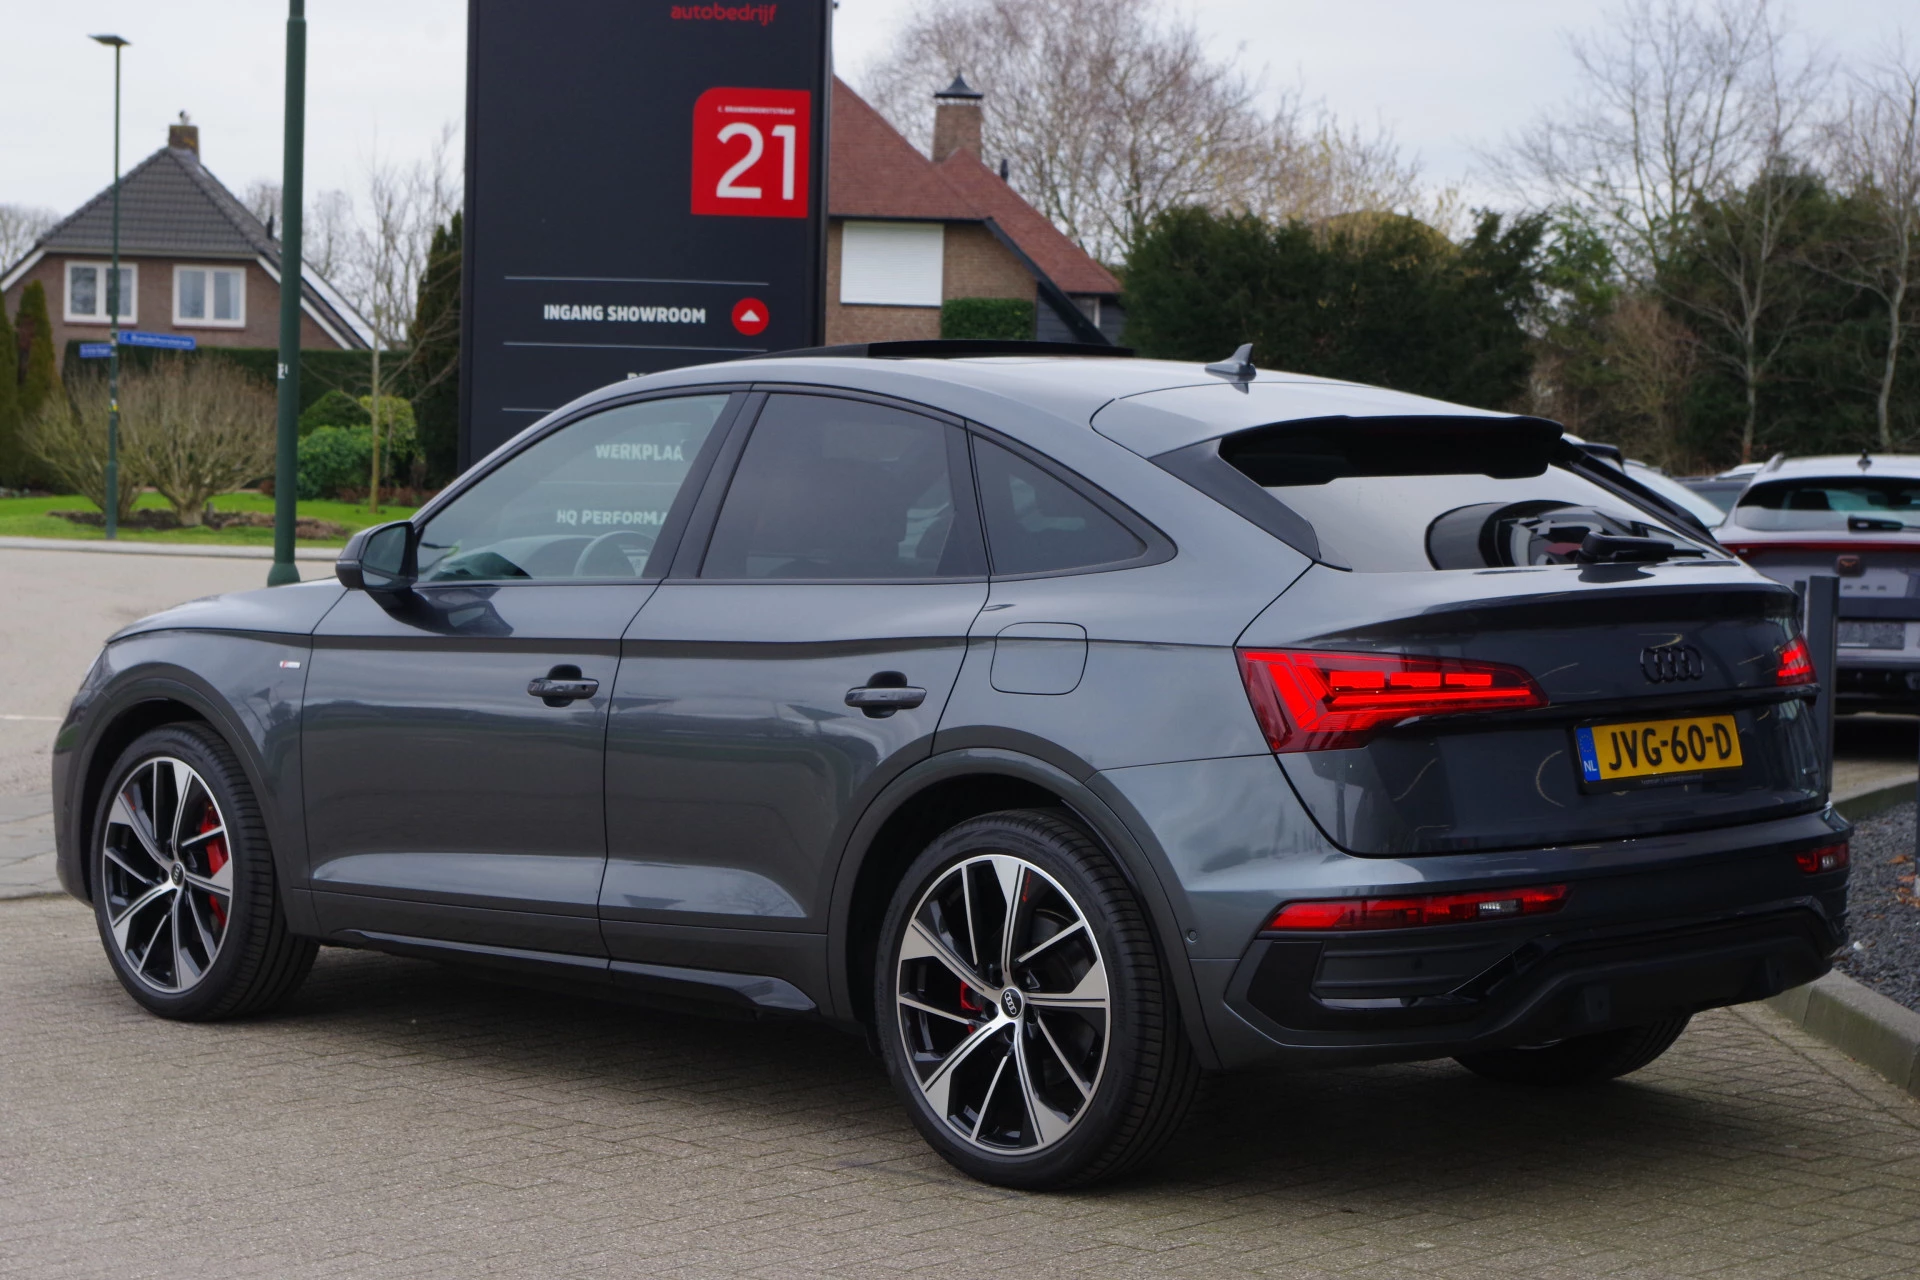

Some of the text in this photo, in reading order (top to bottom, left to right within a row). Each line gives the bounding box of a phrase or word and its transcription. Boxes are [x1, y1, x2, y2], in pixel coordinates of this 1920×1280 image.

[671, 2, 776, 26] autobedrijf
[716, 122, 796, 200] 21
[544, 304, 706, 324] INGANG SHOWROOM
[595, 443, 683, 461] WERKPLAA
[556, 509, 578, 526] HQ
[1609, 722, 1732, 771] JVG-60-D
[1583, 760, 1598, 773] NL
